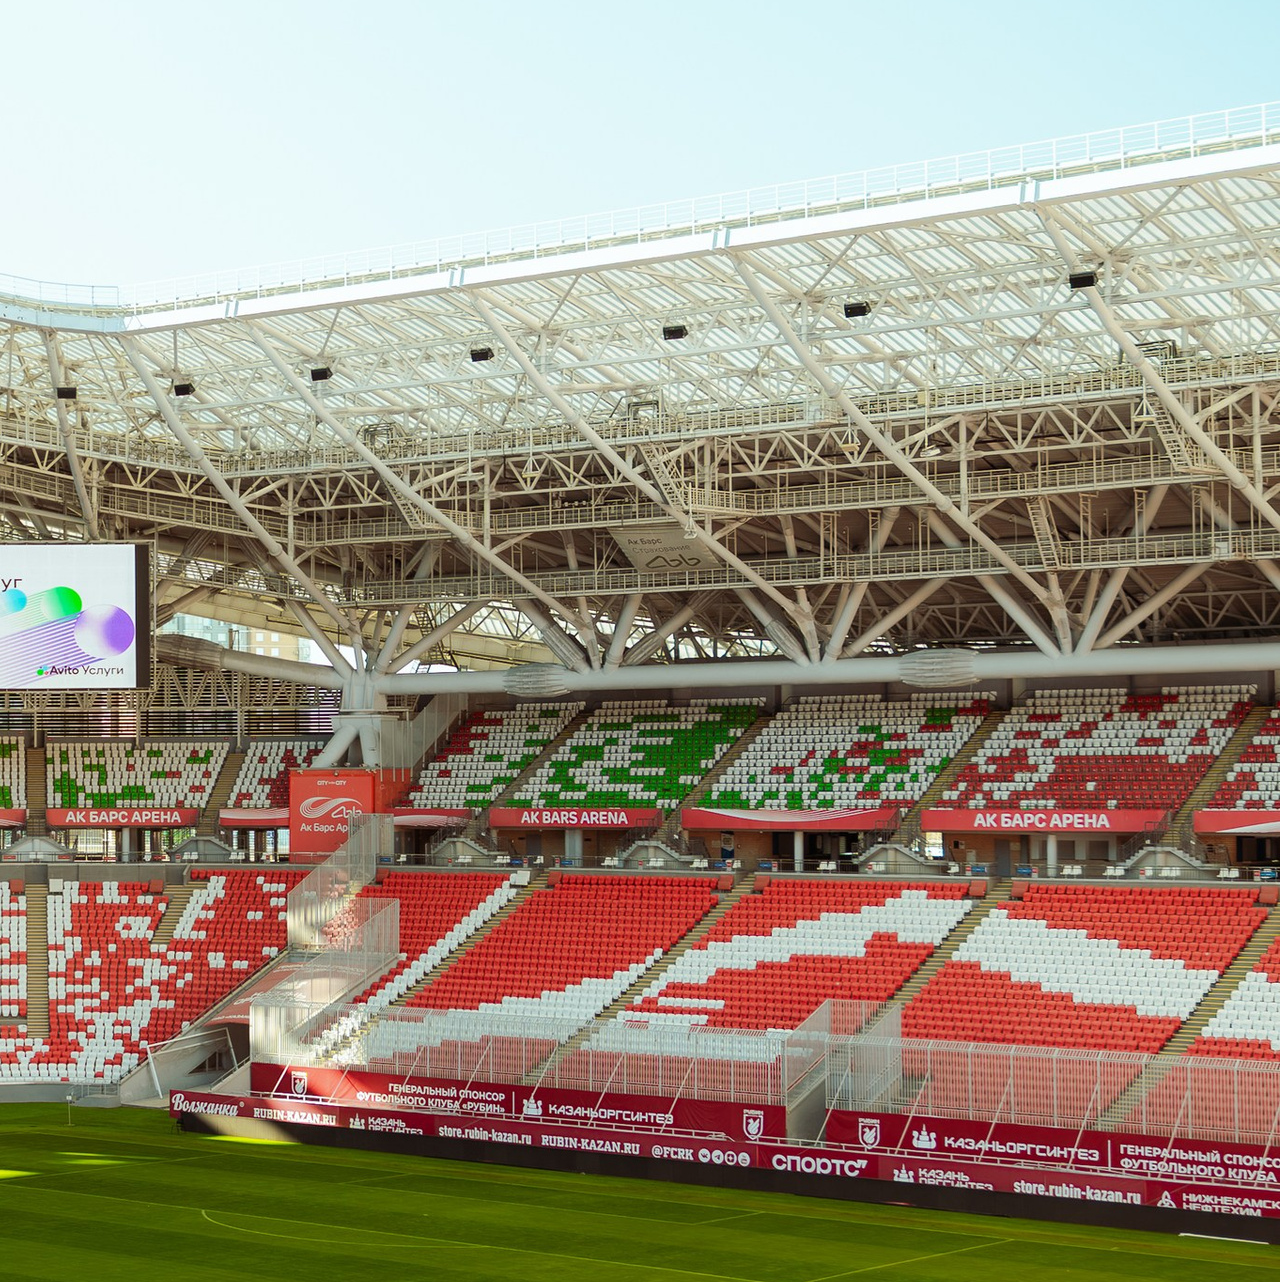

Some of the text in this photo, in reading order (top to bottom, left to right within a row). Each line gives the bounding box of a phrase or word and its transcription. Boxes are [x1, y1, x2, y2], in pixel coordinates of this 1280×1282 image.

[632, 544, 691, 554] Страхование
[640, 537, 662, 546] Барс
[49, 665, 124, 677] Avito Услуги
[65, 811, 182, 823] АК БАРС АРЕНА
[521, 811, 628, 825] AK BARS ARENA
[973, 813, 1110, 828] АК БАРС АРЕНА
[300, 823, 312, 832] Ак
[314, 822, 335, 833] Барс
[388, 1083, 506, 1102] ГЕНЕРАЛЬНЫЙ СПОНСОР
[356, 1091, 505, 1114] ФУТБОЛЬНОГО КЛУБА «РУБИН»
[253, 1107, 337, 1126] RUBIN-KAZAN.RU
[368, 1116, 406, 1127] КАЗАНЬ
[548, 1104, 674, 1124] КАЗАНЬОРГСИНТЕЗ
[439, 1125, 532, 1145] store.rubin-kazan.ru
[541, 1134, 640, 1155] RUBIN-KAZAN.RU
[944, 1136, 1100, 1161] КАЗАНЬОРГСИНТЕЗ
[651, 1145, 694, 1161] @FCRK
[1120, 1144, 1221, 1164] ГЕНЕРАЛЬНЫЙ
[919, 1168, 971, 1182] КАЗАНЬ
[1120, 1158, 1277, 1183] ФУТБОЛЬНОГО КЛУБА
[1013, 1180, 1141, 1205] store.rubin-kazan.ru
[1182, 1203, 1262, 1217] НЕФТЕХИМ
